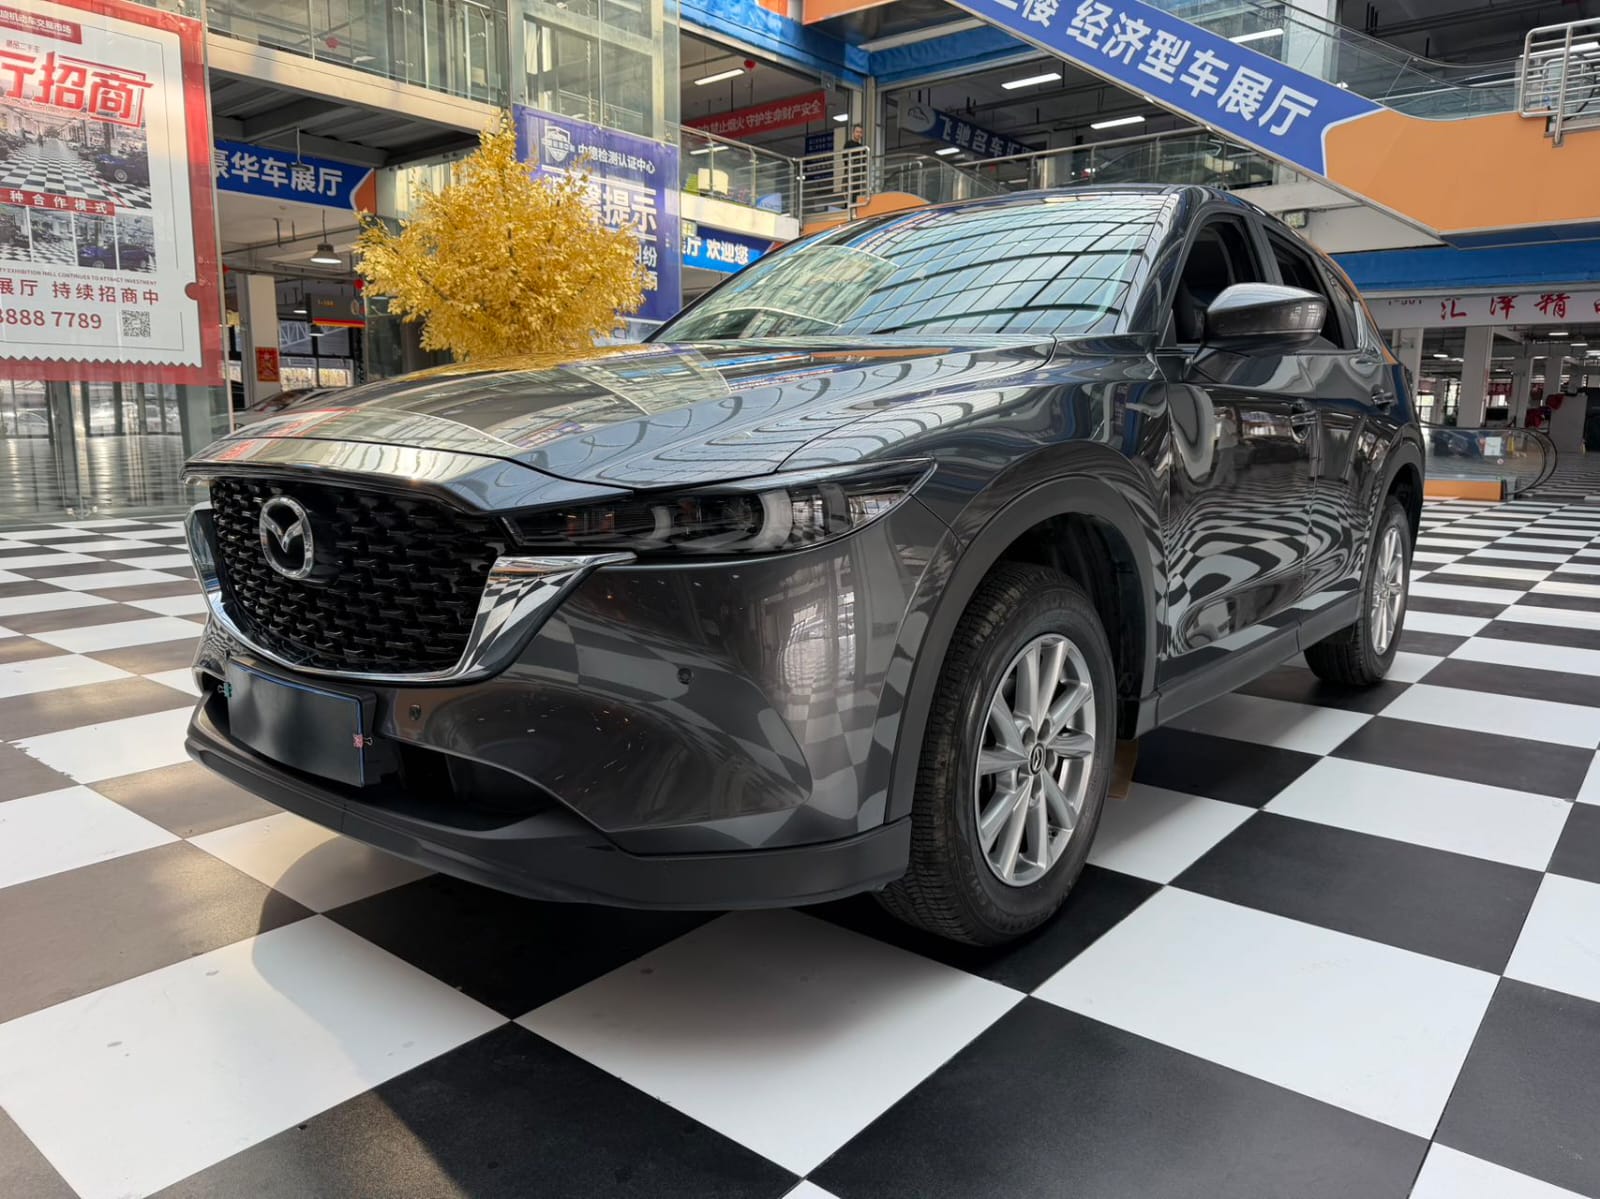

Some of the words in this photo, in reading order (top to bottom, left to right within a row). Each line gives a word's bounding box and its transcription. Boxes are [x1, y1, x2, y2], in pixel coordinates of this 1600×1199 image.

[993, 0, 1060, 28] 楼
[1066, 0, 1318, 136] 经济型车展厅
[706, 238, 749, 265] 欢迎您
[52, 280, 159, 306] 持续招商中
[51, 311, 102, 329] 7789
